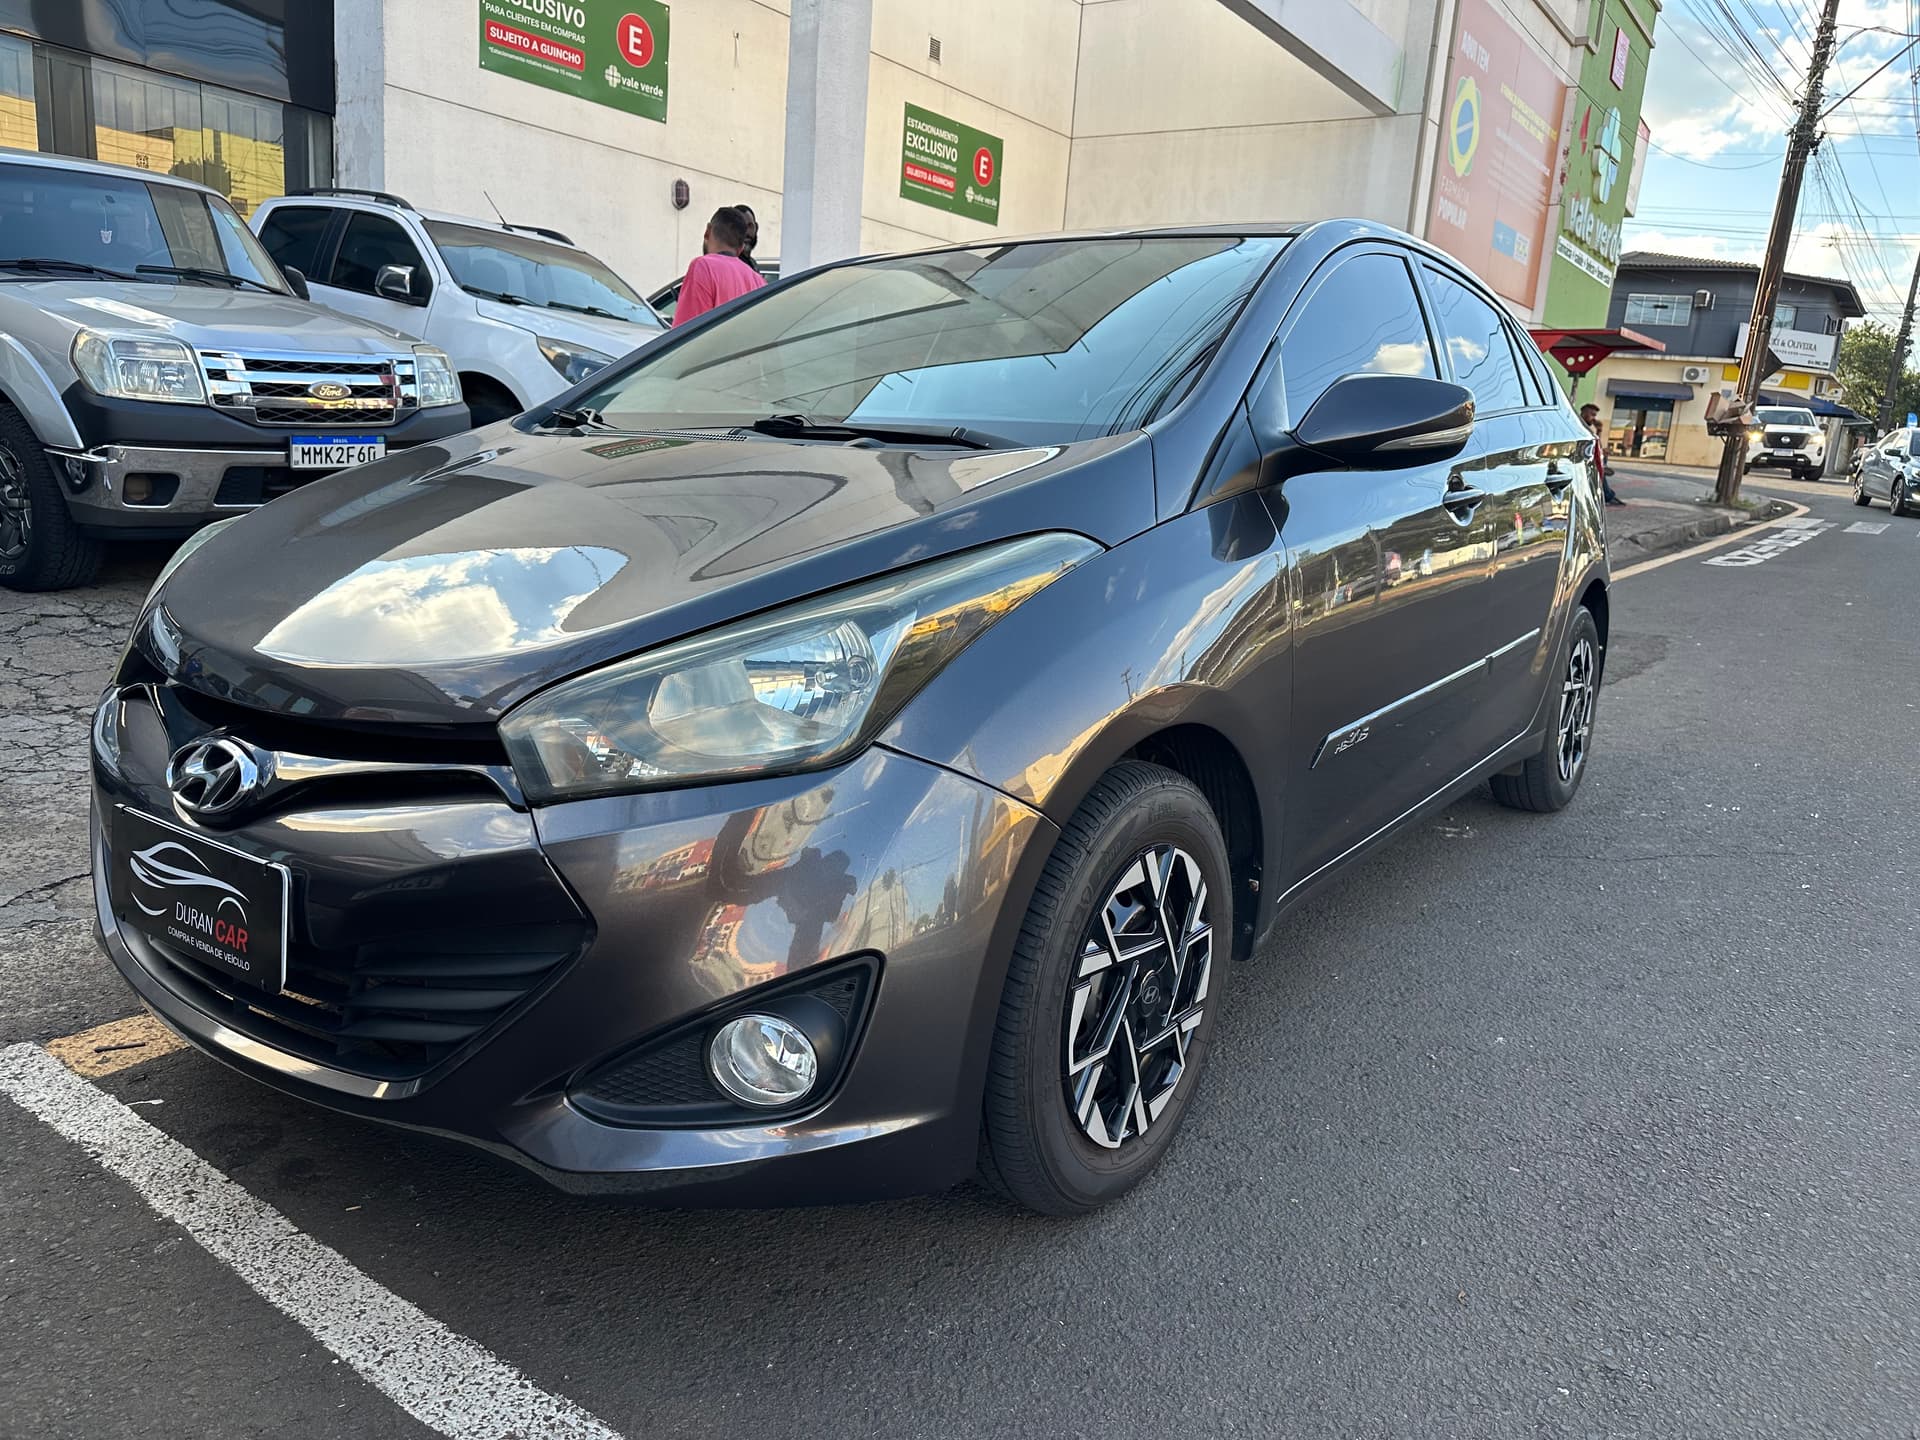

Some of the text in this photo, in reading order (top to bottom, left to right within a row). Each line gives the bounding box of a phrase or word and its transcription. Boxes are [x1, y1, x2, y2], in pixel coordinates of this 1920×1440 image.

[485, 2, 586, 44] PARA CLIENTES EM COMPRAS
[505, 0, 586, 28] LUSIVO
[489, 26, 582, 65] SUJEITO A GUINCHO
[629, 24, 643, 57] E
[621, 76, 640, 90] vale
[640, 81, 664, 98] verde
[907, 116, 959, 144] ESTACIONAMENTO
[906, 132, 958, 162] EXCLUSIVO
[979, 155, 989, 179] E
[319, 384, 343, 396] Ford
[175, 901, 249, 953] DURAN CAR
[167, 925, 250, 971] COMPRA E VENDA DE VEÍCULO
